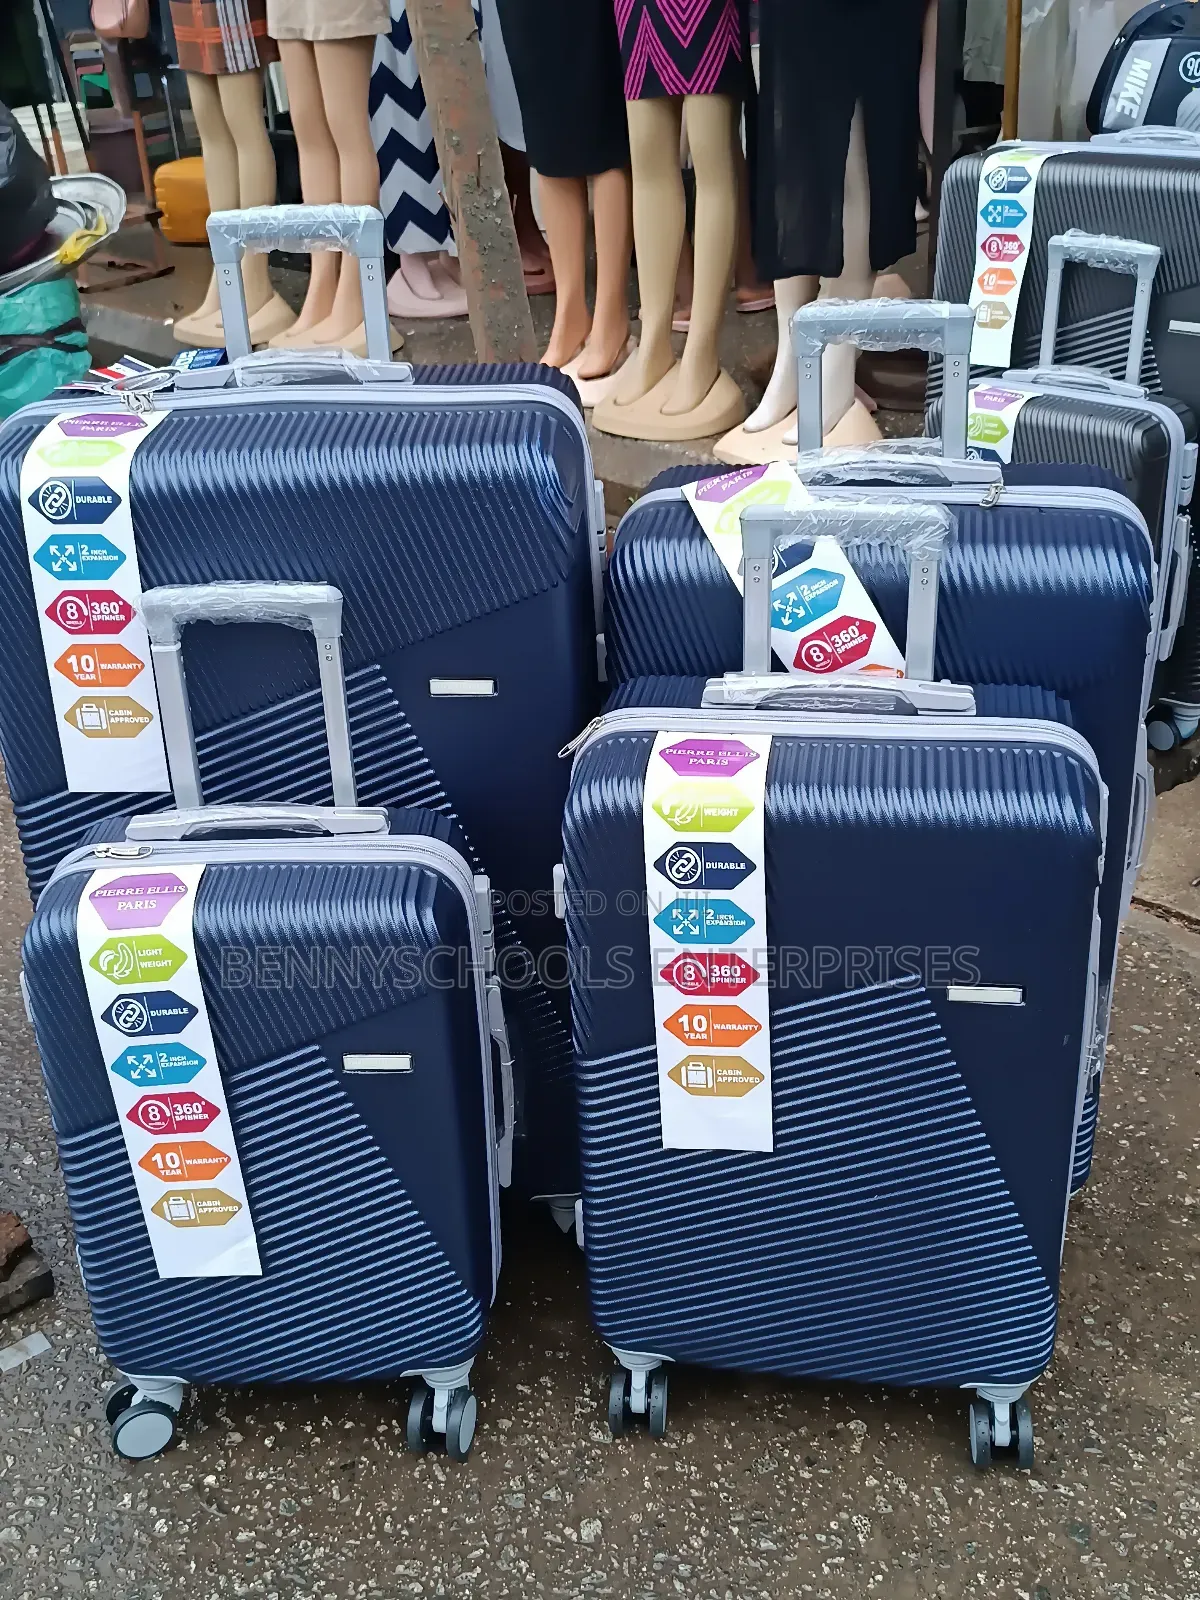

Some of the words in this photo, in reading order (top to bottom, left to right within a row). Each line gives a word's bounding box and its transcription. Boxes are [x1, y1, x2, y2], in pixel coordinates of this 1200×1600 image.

[1116, 58, 1152, 119] MIKE
[983, 273, 997, 287] 10
[75, 496, 113, 504] DURABLE
[81, 544, 90, 555] 2
[800, 584, 811, 594] 2
[66, 602, 79, 620] 8
[836, 633, 868, 654] SPINNER
[809, 646, 825, 662] 8
[67, 654, 95, 673] 10
[110, 716, 150, 724] APPROVED
[665, 748, 715, 756] PIERRE
[718, 750, 757, 758] ELLIS
[688, 758, 729, 766] PARIS
[703, 807, 739, 817] WEIGHT
[705, 861, 746, 870] DURABLE
[94, 887, 145, 897] PIERRE
[147, 885, 186, 894] ELLIS
[117, 899, 157, 911] PARIS
[706, 909, 715, 920] 2
[138, 948, 163, 957] LIGHT
[140, 960, 173, 969] WEIGHT
[683, 964, 696, 981] 8
[150, 1007, 189, 1017] DURABLE
[677, 1014, 707, 1032] 10
[713, 1023, 760, 1031] WARRANTY
[159, 1053, 168, 1063] 2
[717, 1068, 743, 1076] CABIN
[716, 1076, 760, 1084] APPROVED
[147, 1105, 161, 1121] 8
[174, 1113, 209, 1122] SPINNER
[151, 1152, 181, 1169] 10
[185, 1156, 229, 1165] WARRANTY
[198, 1205, 239, 1213] APPROVED
